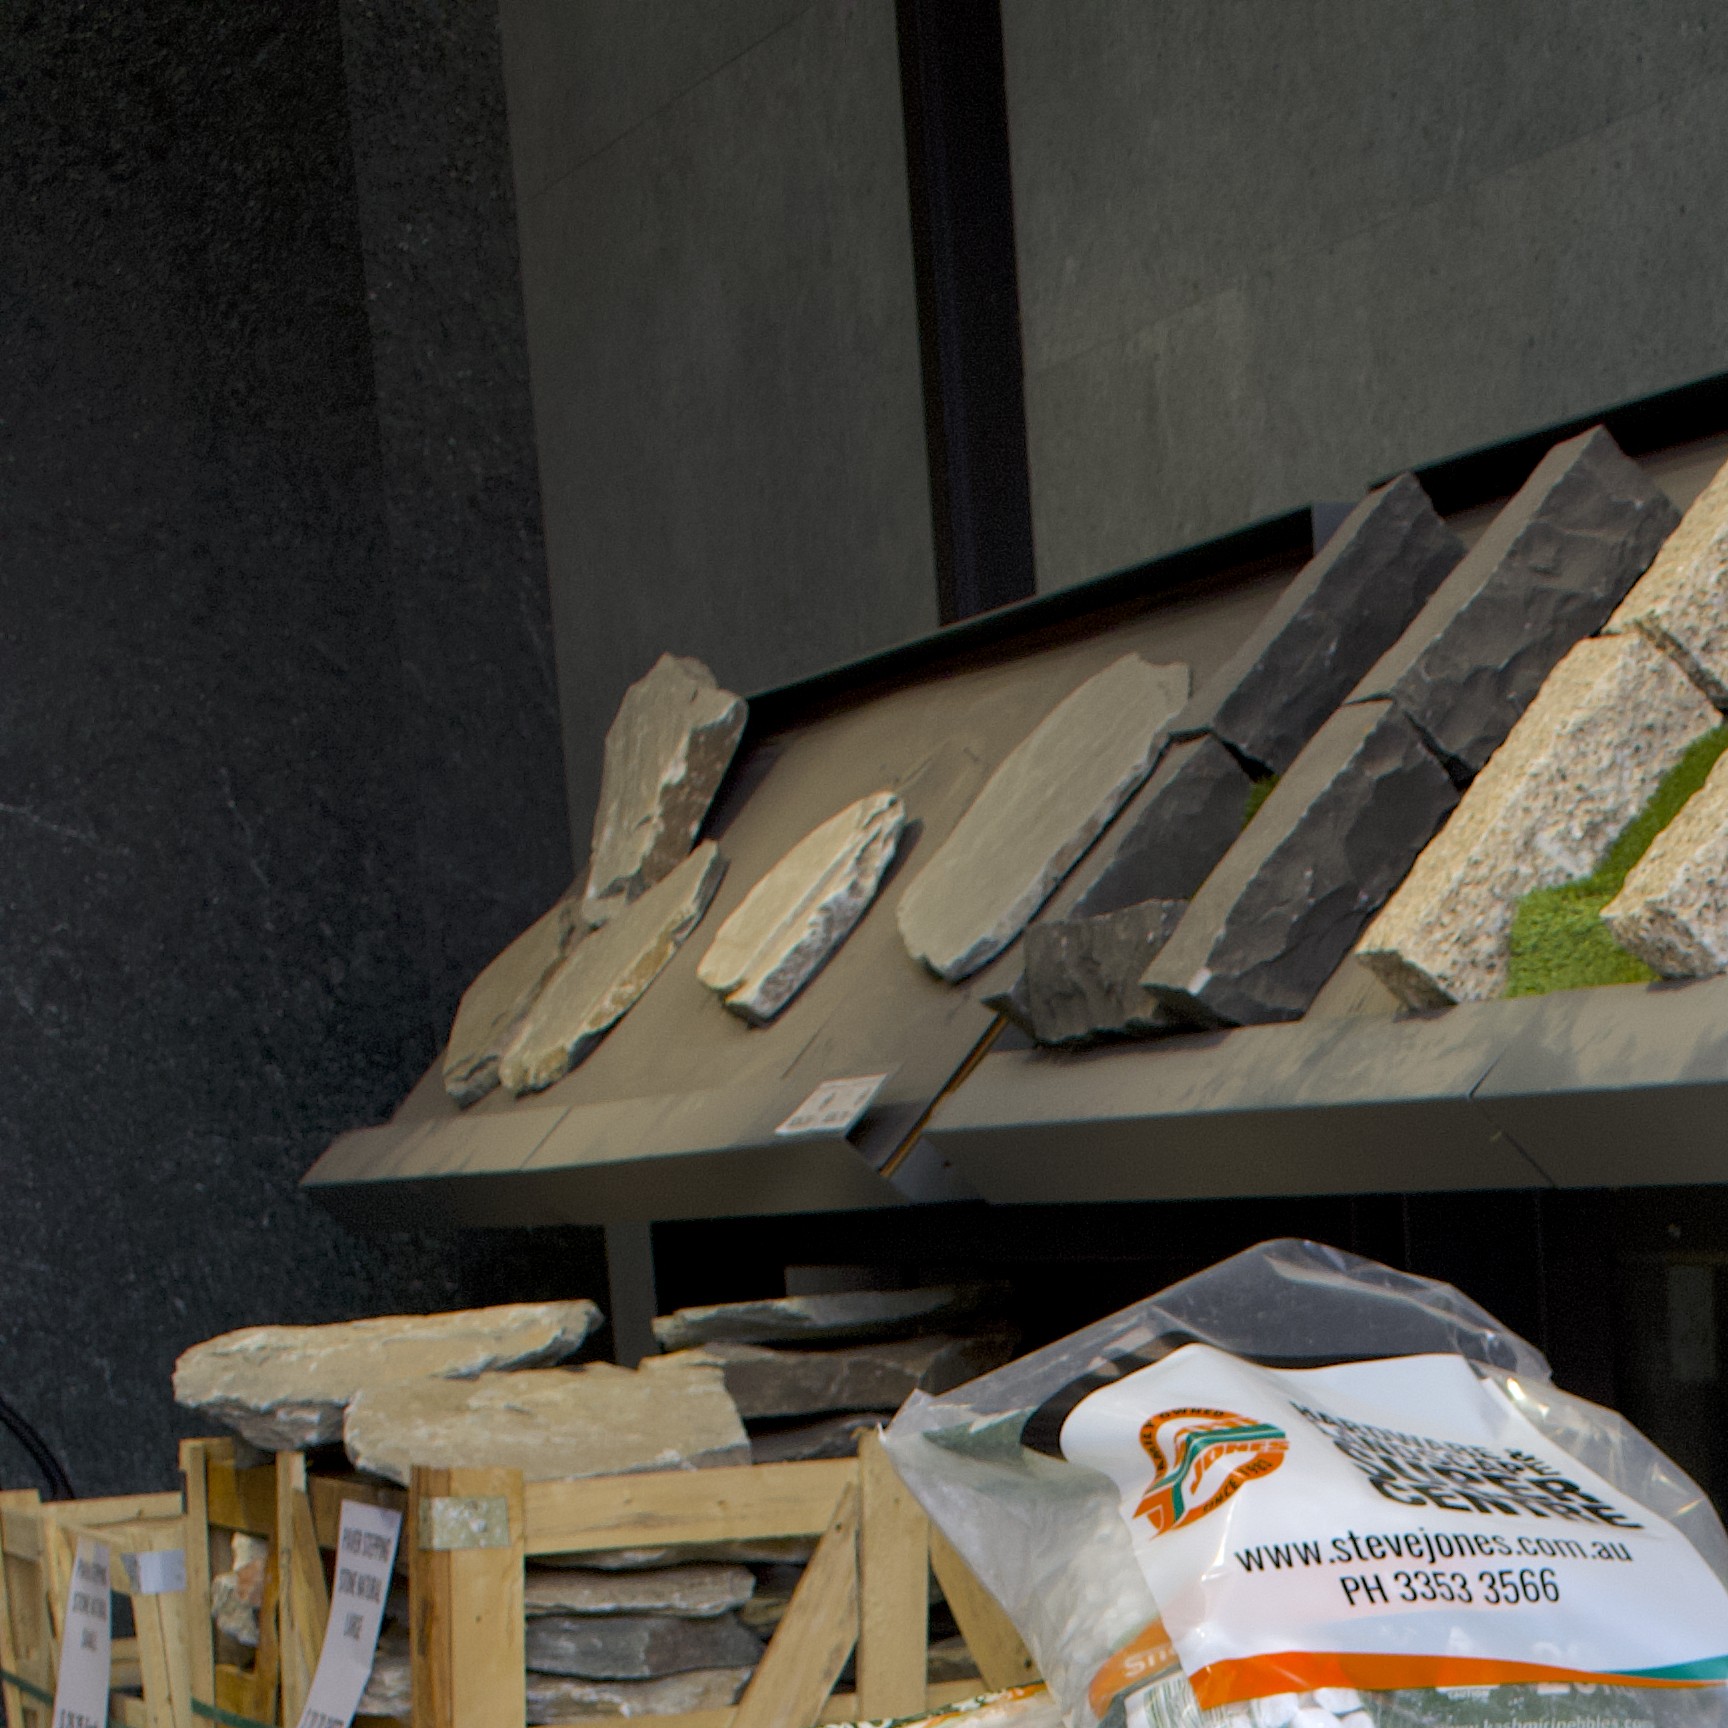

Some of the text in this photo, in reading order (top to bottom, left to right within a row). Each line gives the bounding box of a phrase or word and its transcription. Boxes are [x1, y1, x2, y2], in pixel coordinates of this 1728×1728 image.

[1234, 1526, 1635, 1573] www.stevejones.com.au
[1340, 1568, 1562, 1608] PH 3353 3566
